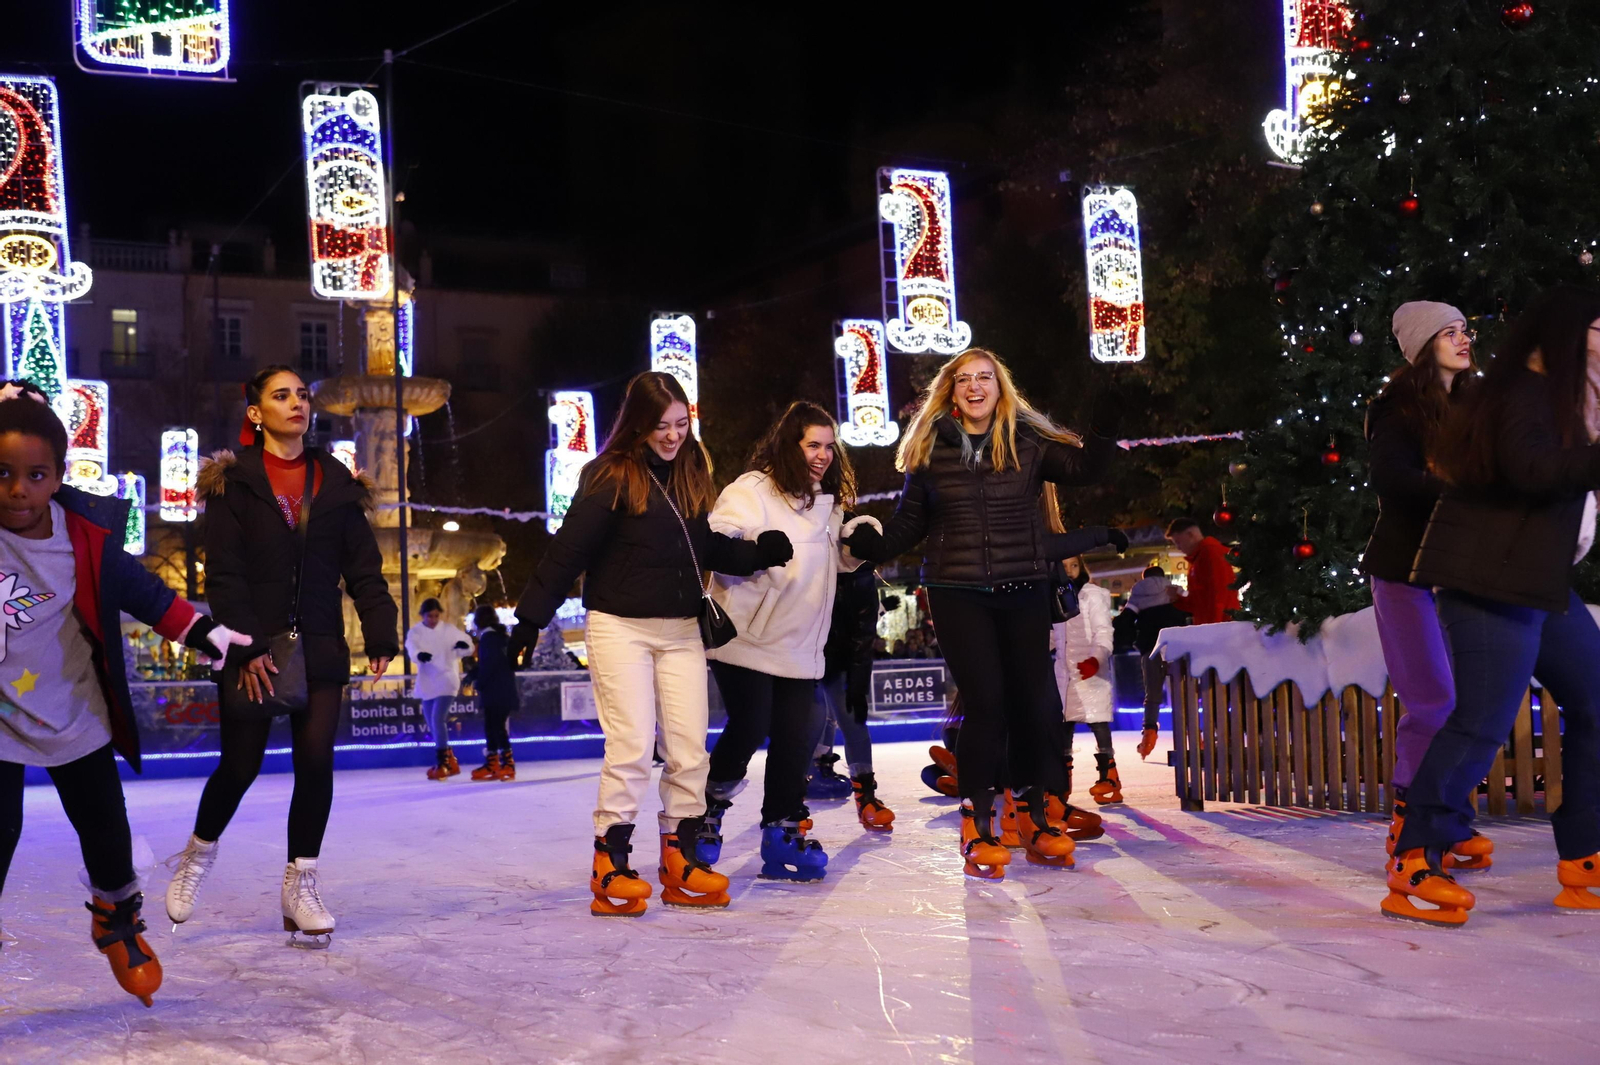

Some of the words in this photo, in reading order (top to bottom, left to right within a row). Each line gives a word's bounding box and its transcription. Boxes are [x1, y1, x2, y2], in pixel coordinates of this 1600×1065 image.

[883, 676, 934, 690] AEDAS
[883, 691, 934, 704] HOMES
[351, 705, 398, 719] bonita
[401, 704, 415, 716] la
[352, 723, 398, 737] bonita
[402, 722, 416, 734] la
